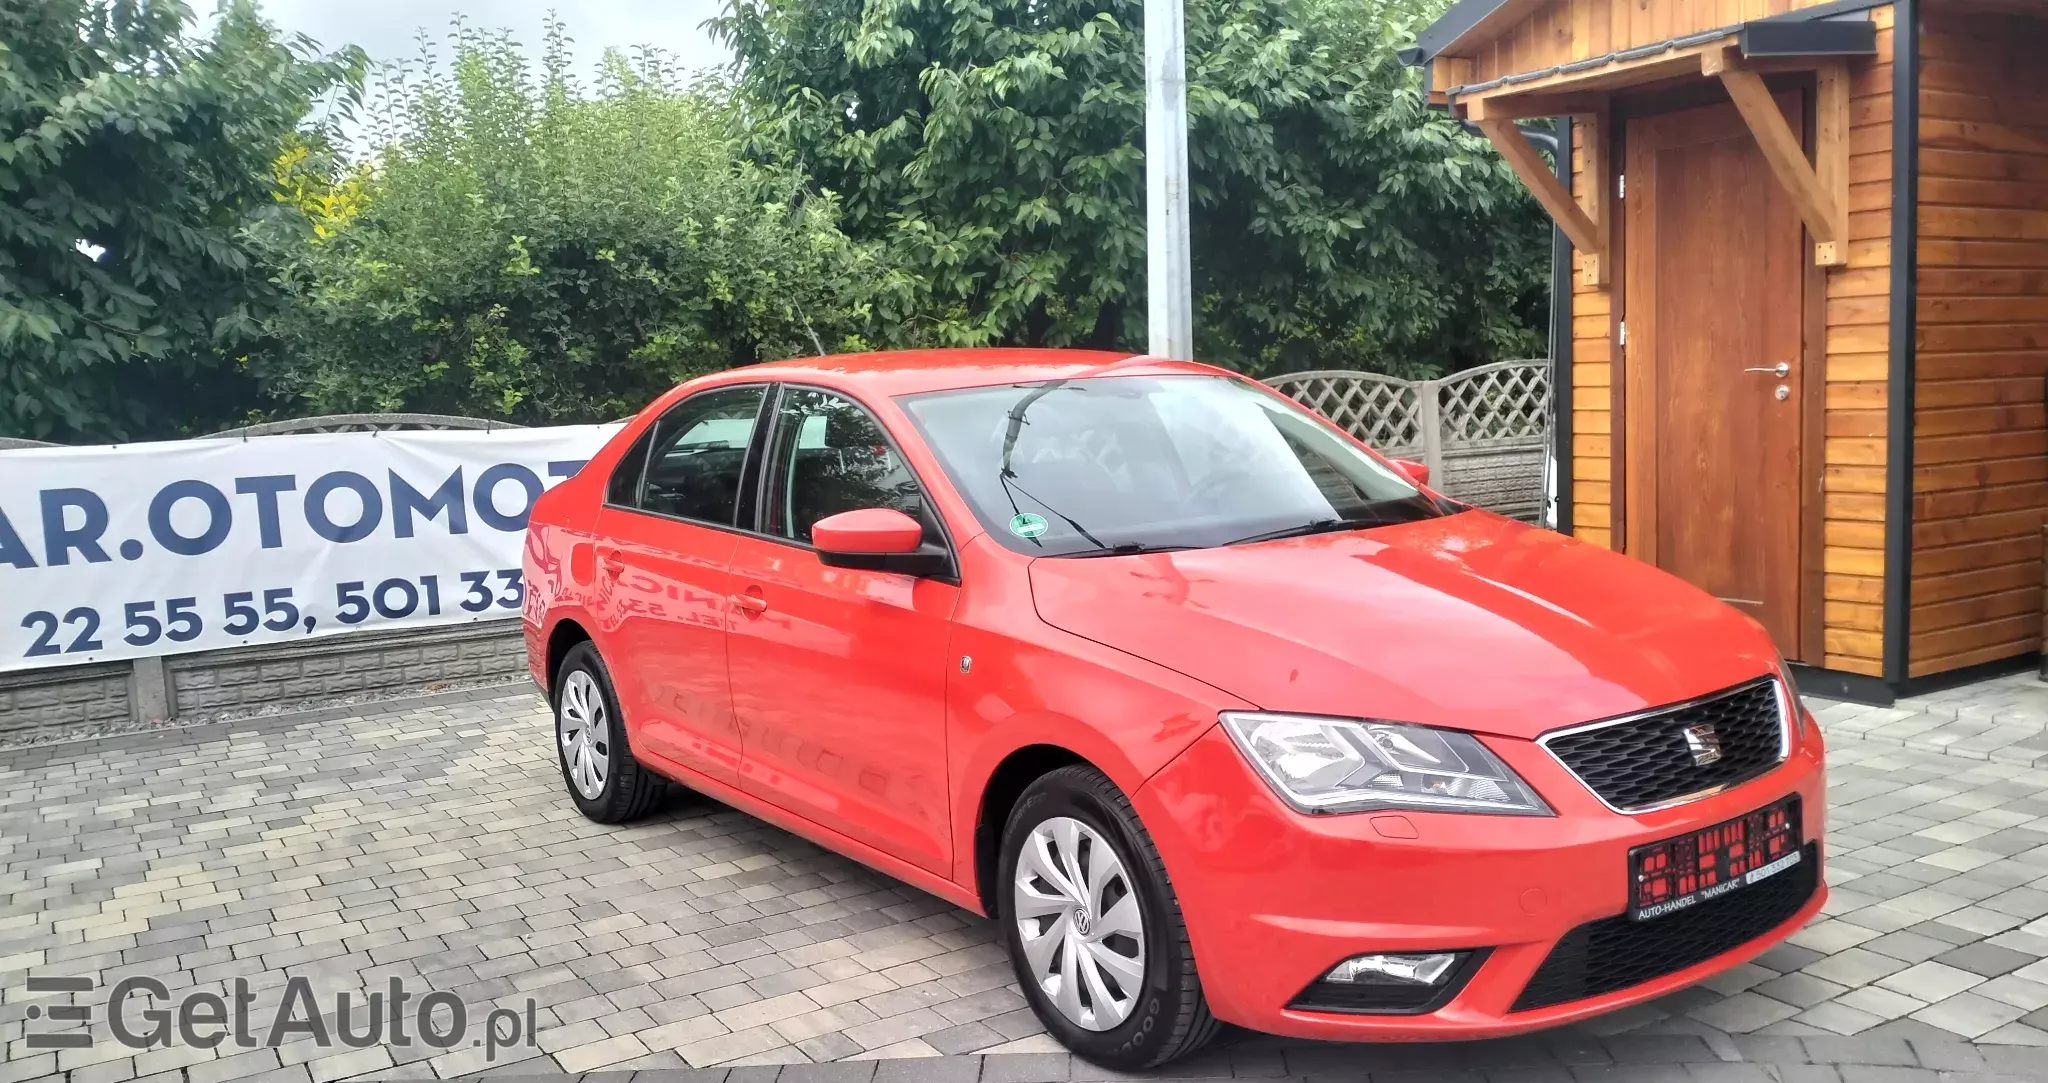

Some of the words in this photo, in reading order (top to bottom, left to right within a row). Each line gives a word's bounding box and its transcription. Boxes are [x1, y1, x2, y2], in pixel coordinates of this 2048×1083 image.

[21, 607, 104, 657] 22
[124, 596, 203, 646] 55
[223, 588, 317, 634] 55,
[335, 574, 441, 624] 501
[1638, 895, 1696, 920] AUTO-HANDEL
